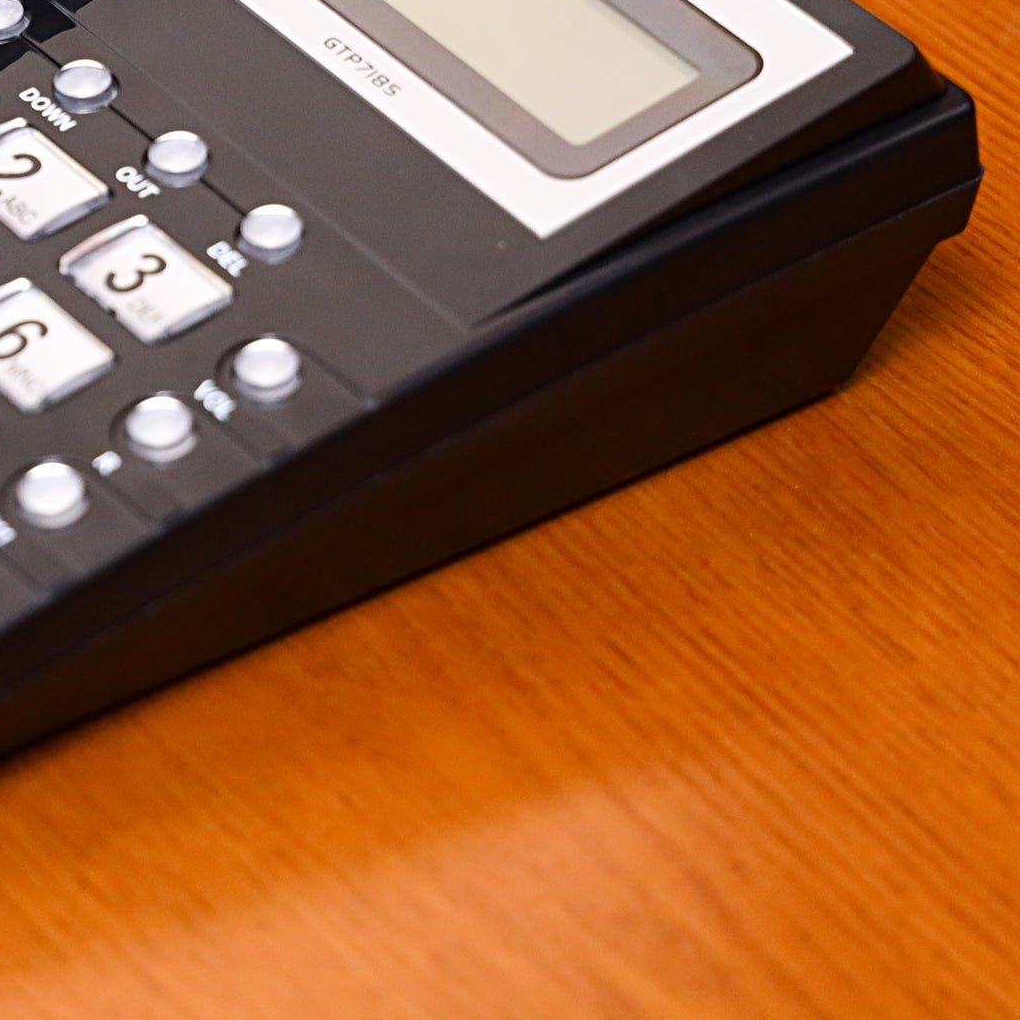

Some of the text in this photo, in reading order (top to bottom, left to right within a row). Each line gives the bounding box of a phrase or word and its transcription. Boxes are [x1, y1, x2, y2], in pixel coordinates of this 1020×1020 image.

[18, 87, 77, 131] DOWN
[115, 166, 161, 199] OUT
[104, 253, 167, 293] 3
[206, 240, 249, 278] DEL
